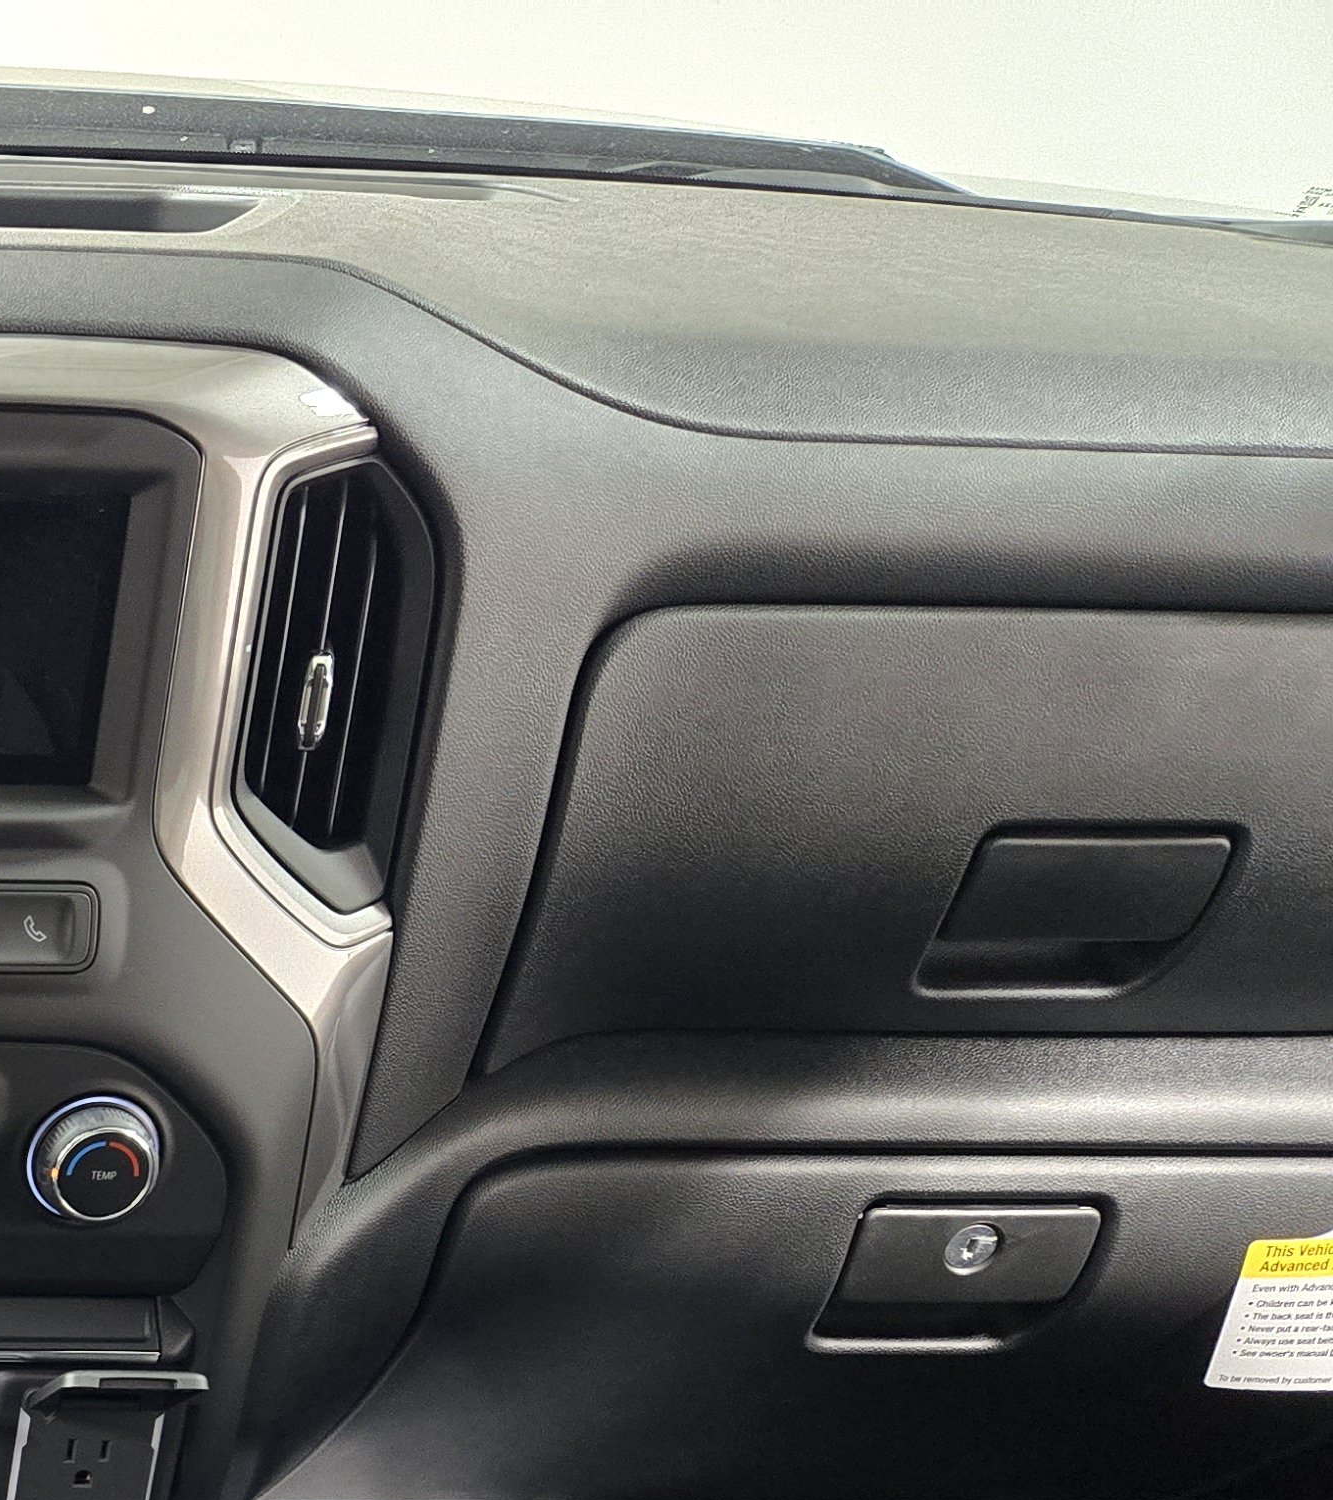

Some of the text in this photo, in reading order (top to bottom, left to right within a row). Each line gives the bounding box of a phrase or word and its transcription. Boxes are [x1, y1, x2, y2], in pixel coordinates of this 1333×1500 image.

[91, 1170, 118, 1181] TEMP
[1265, 1245, 1294, 1257] This
[1259, 1258, 1330, 1272] Advanced
[1252, 1284, 1276, 1293] Even
[1279, 1283, 1299, 1292] with
[1255, 1300, 1295, 1308] Children
[1316, 1299, 1328, 1307] be
[1252, 1312, 1269, 1320] The
[1271, 1312, 1292, 1320] back
[1294, 1312, 1315, 1320] seat
[1247, 1325, 1275, 1333] Never
[1275, 1325, 1292, 1334] put
[1243, 1337, 1276, 1346] Always
[1296, 1337, 1317, 1345] seat
[1219, 1374, 1332, 1385] To be removed by customer
